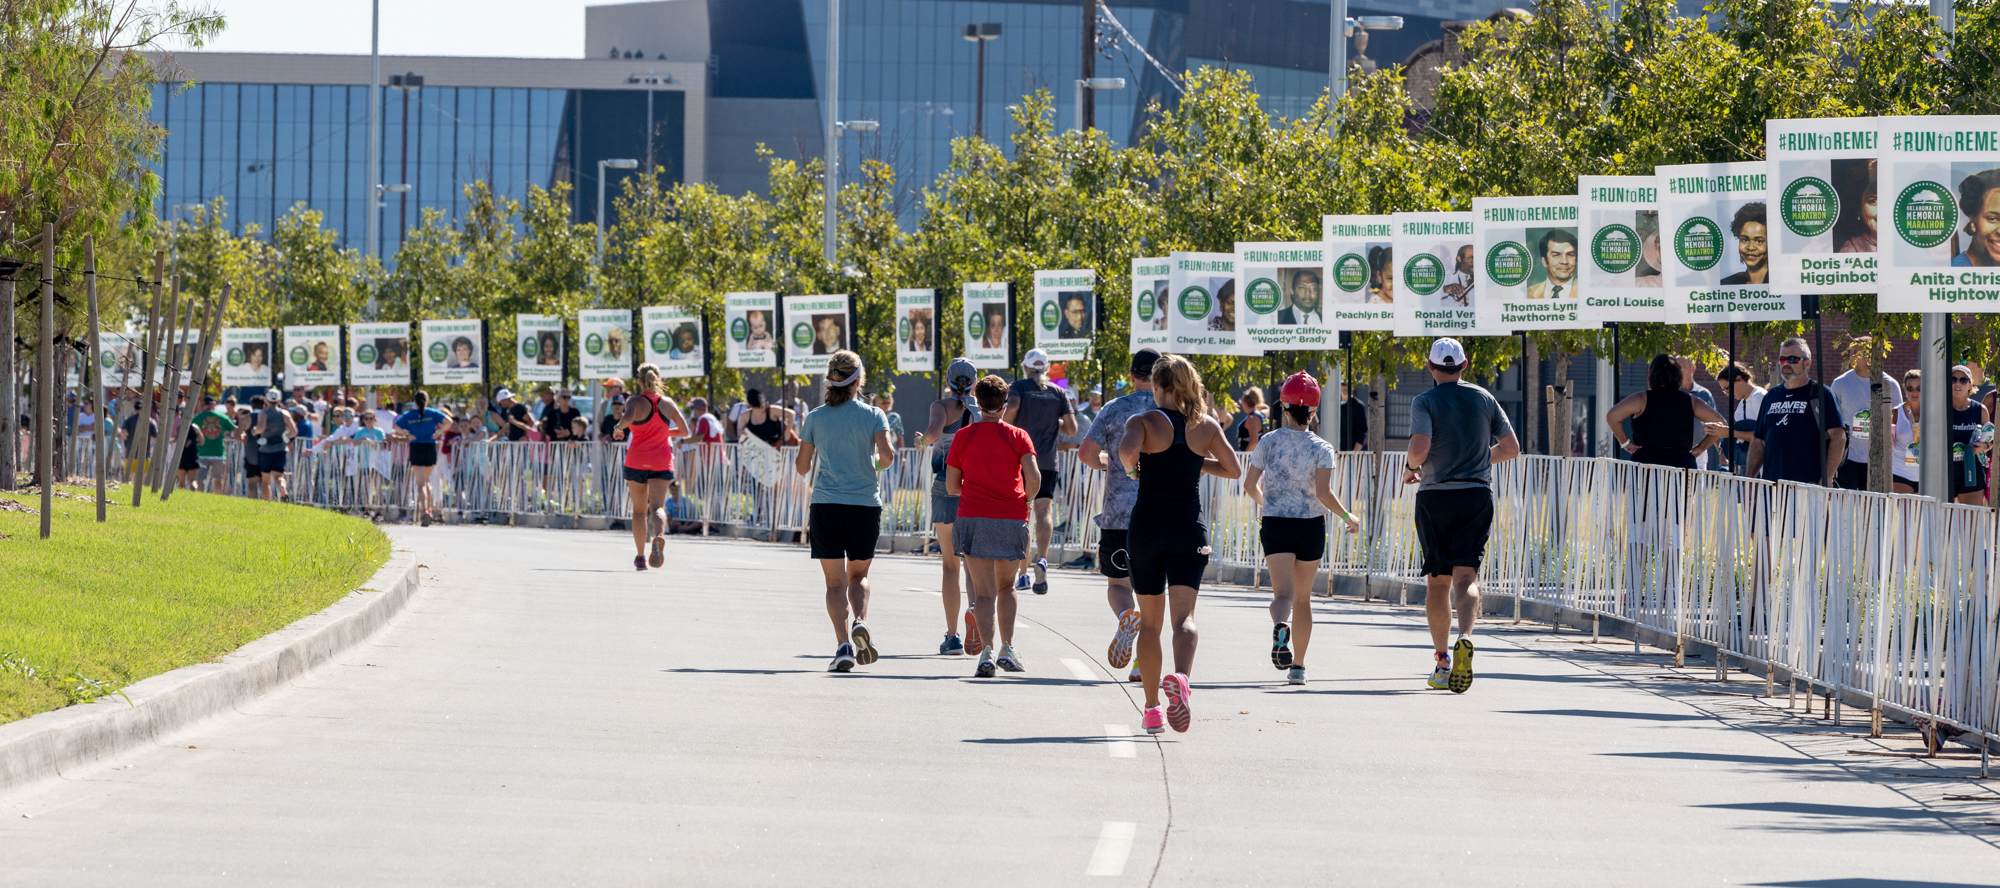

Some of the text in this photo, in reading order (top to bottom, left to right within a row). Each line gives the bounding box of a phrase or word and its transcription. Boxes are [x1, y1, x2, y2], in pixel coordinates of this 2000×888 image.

[1893, 131, 1998, 152] #RUNtoREME
[1669, 174, 1767, 194] #RUNtoREMEMB
[1792, 204, 1826, 212] MEMORIAL
[1792, 212, 1827, 220] MARATHON
[1906, 211, 1945, 220] MEMORIAL
[1402, 221, 1474, 235] #RUNtoREME
[1906, 220, 1945, 229] MARATHON
[1684, 241, 1714, 249] MEMORIAL
[1685, 248, 1715, 256] MARATHON
[1801, 258, 1841, 270] Doris
[1801, 271, 1878, 286] Higginbot
[1910, 272, 2000, 286] Anita Chris
[1689, 289, 1736, 302] Castine
[1929, 288, 2000, 303] Hightow
[1503, 302, 1550, 312] Thomas
[1586, 297, 1665, 307] Carol Louise
[1687, 301, 1786, 314] Hearn Deveroux
[1335, 311, 1379, 320] Peachlyn
[1415, 310, 1475, 319] Ronald Ver
[1501, 312, 1566, 322] Hawthorne
[1424, 319, 1468, 329] Harding
[1247, 327, 1295, 335] Woodrow
[1176, 336, 1206, 345] Cheryl
[1208, 337, 1217, 345] E.
[1252, 335, 1327, 345] “Woody” Brady
[1770, 401, 1808, 410] BRAVES
